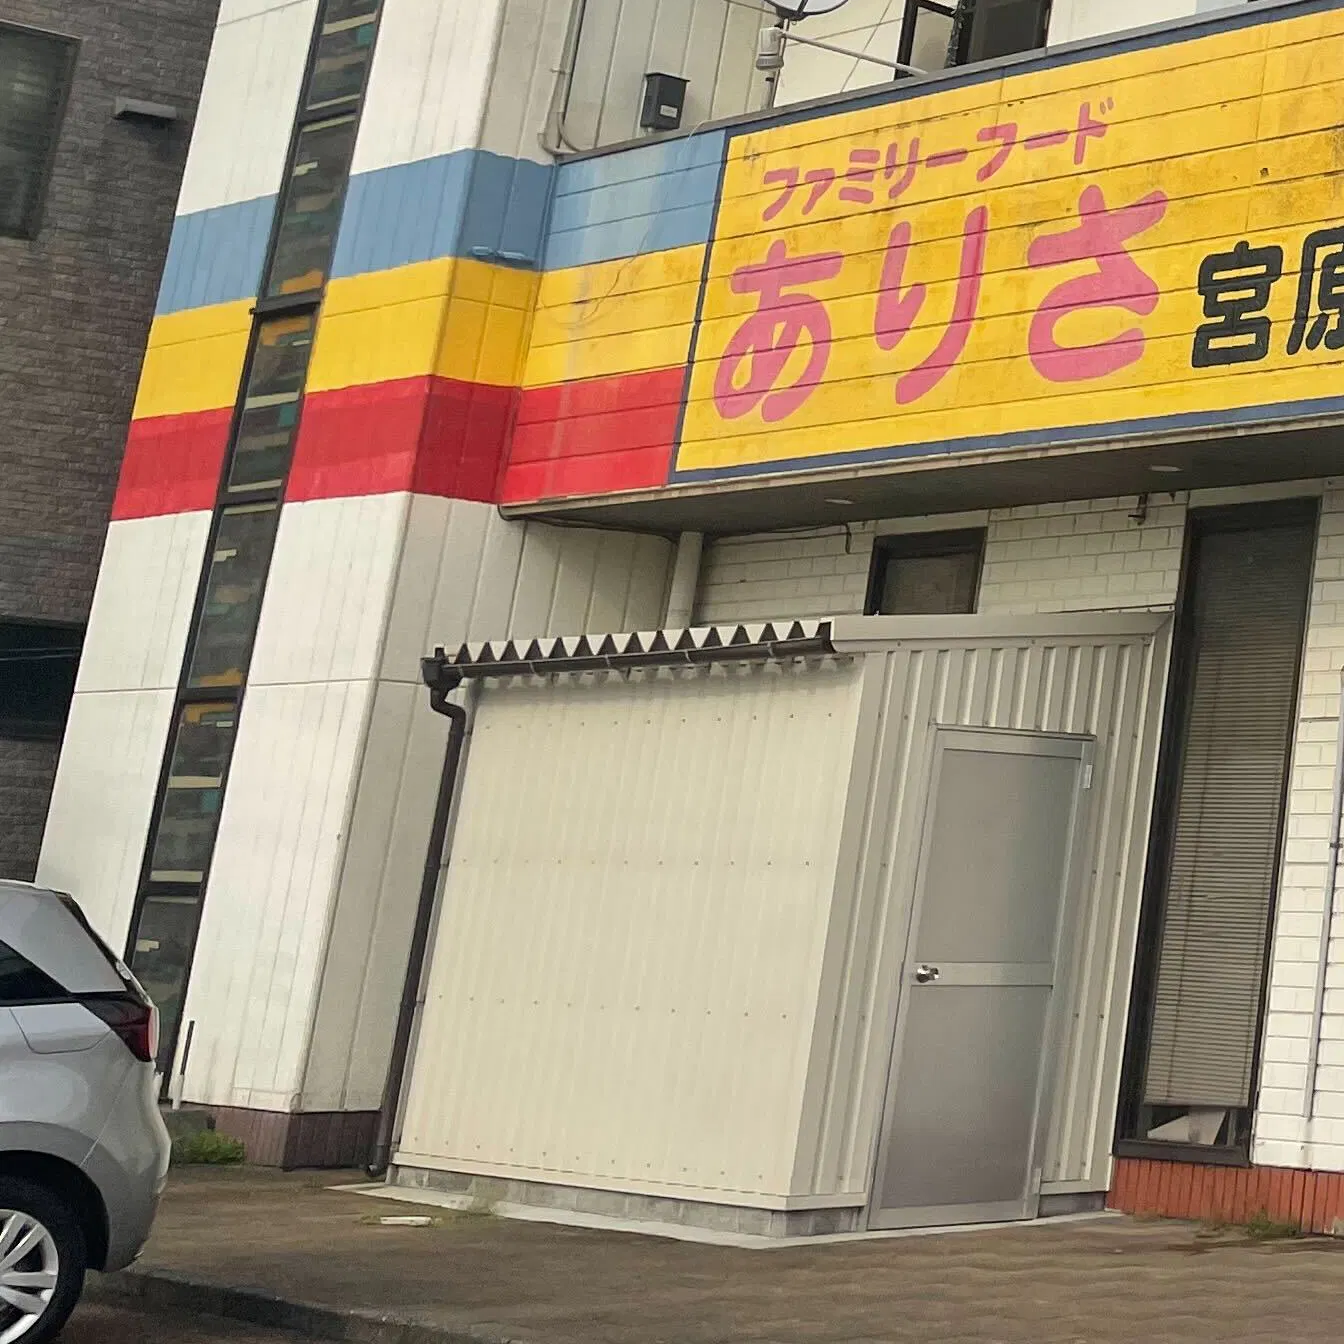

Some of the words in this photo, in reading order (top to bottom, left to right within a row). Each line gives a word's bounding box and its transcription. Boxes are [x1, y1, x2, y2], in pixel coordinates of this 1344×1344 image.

[761, 97, 1115, 223] ファミリーフード
[711, 184, 1170, 424] ありさ
